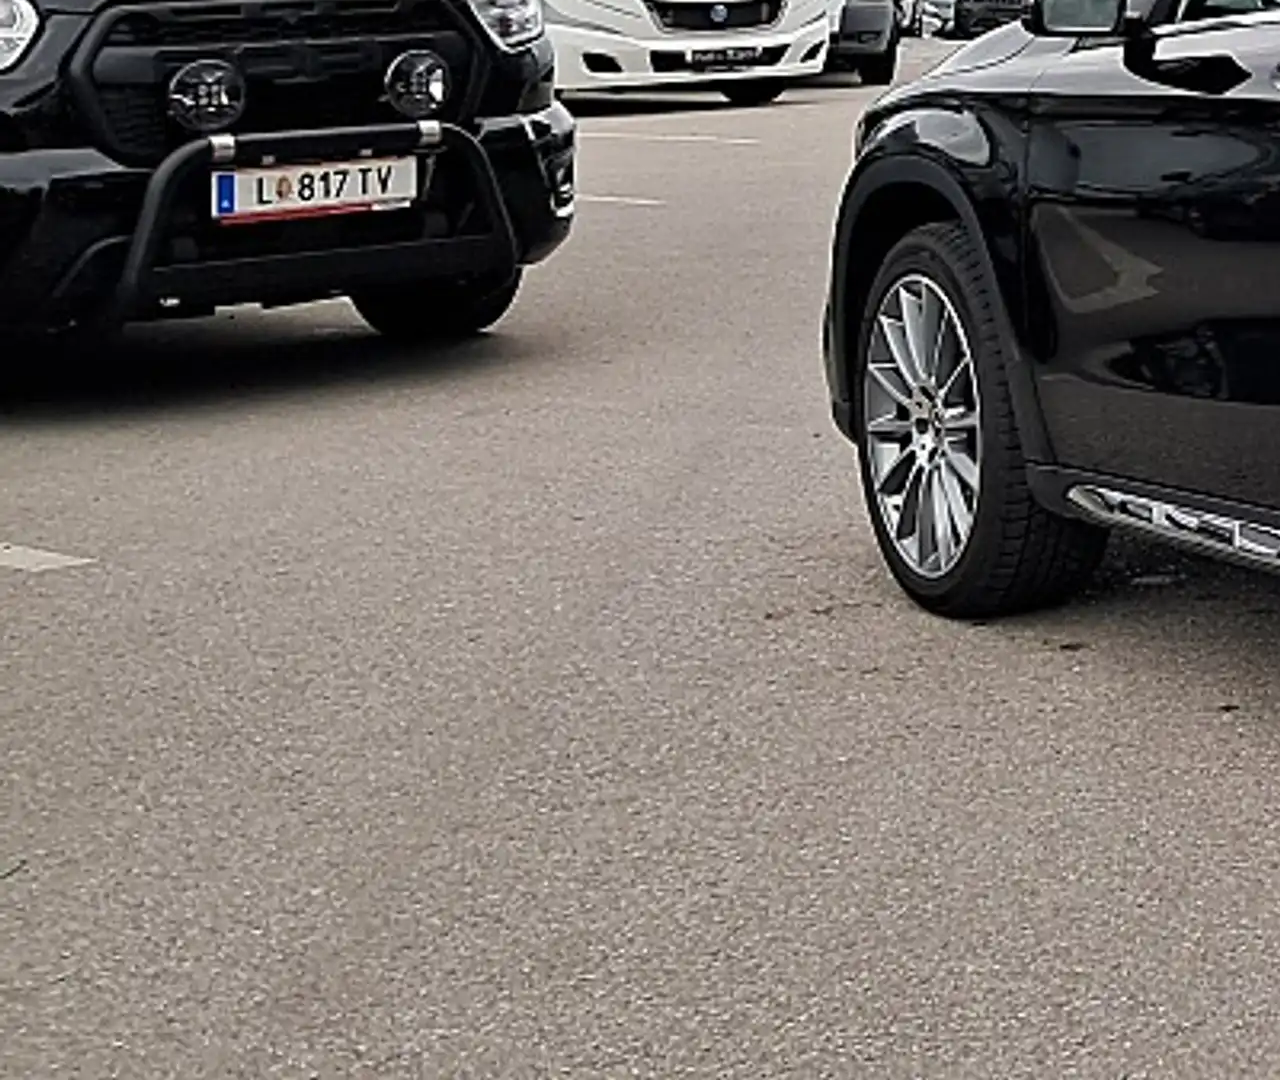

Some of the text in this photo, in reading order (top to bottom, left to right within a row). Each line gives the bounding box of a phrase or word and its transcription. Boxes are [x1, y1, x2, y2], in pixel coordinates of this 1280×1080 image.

[256, 166, 392, 205] L 817 TV
